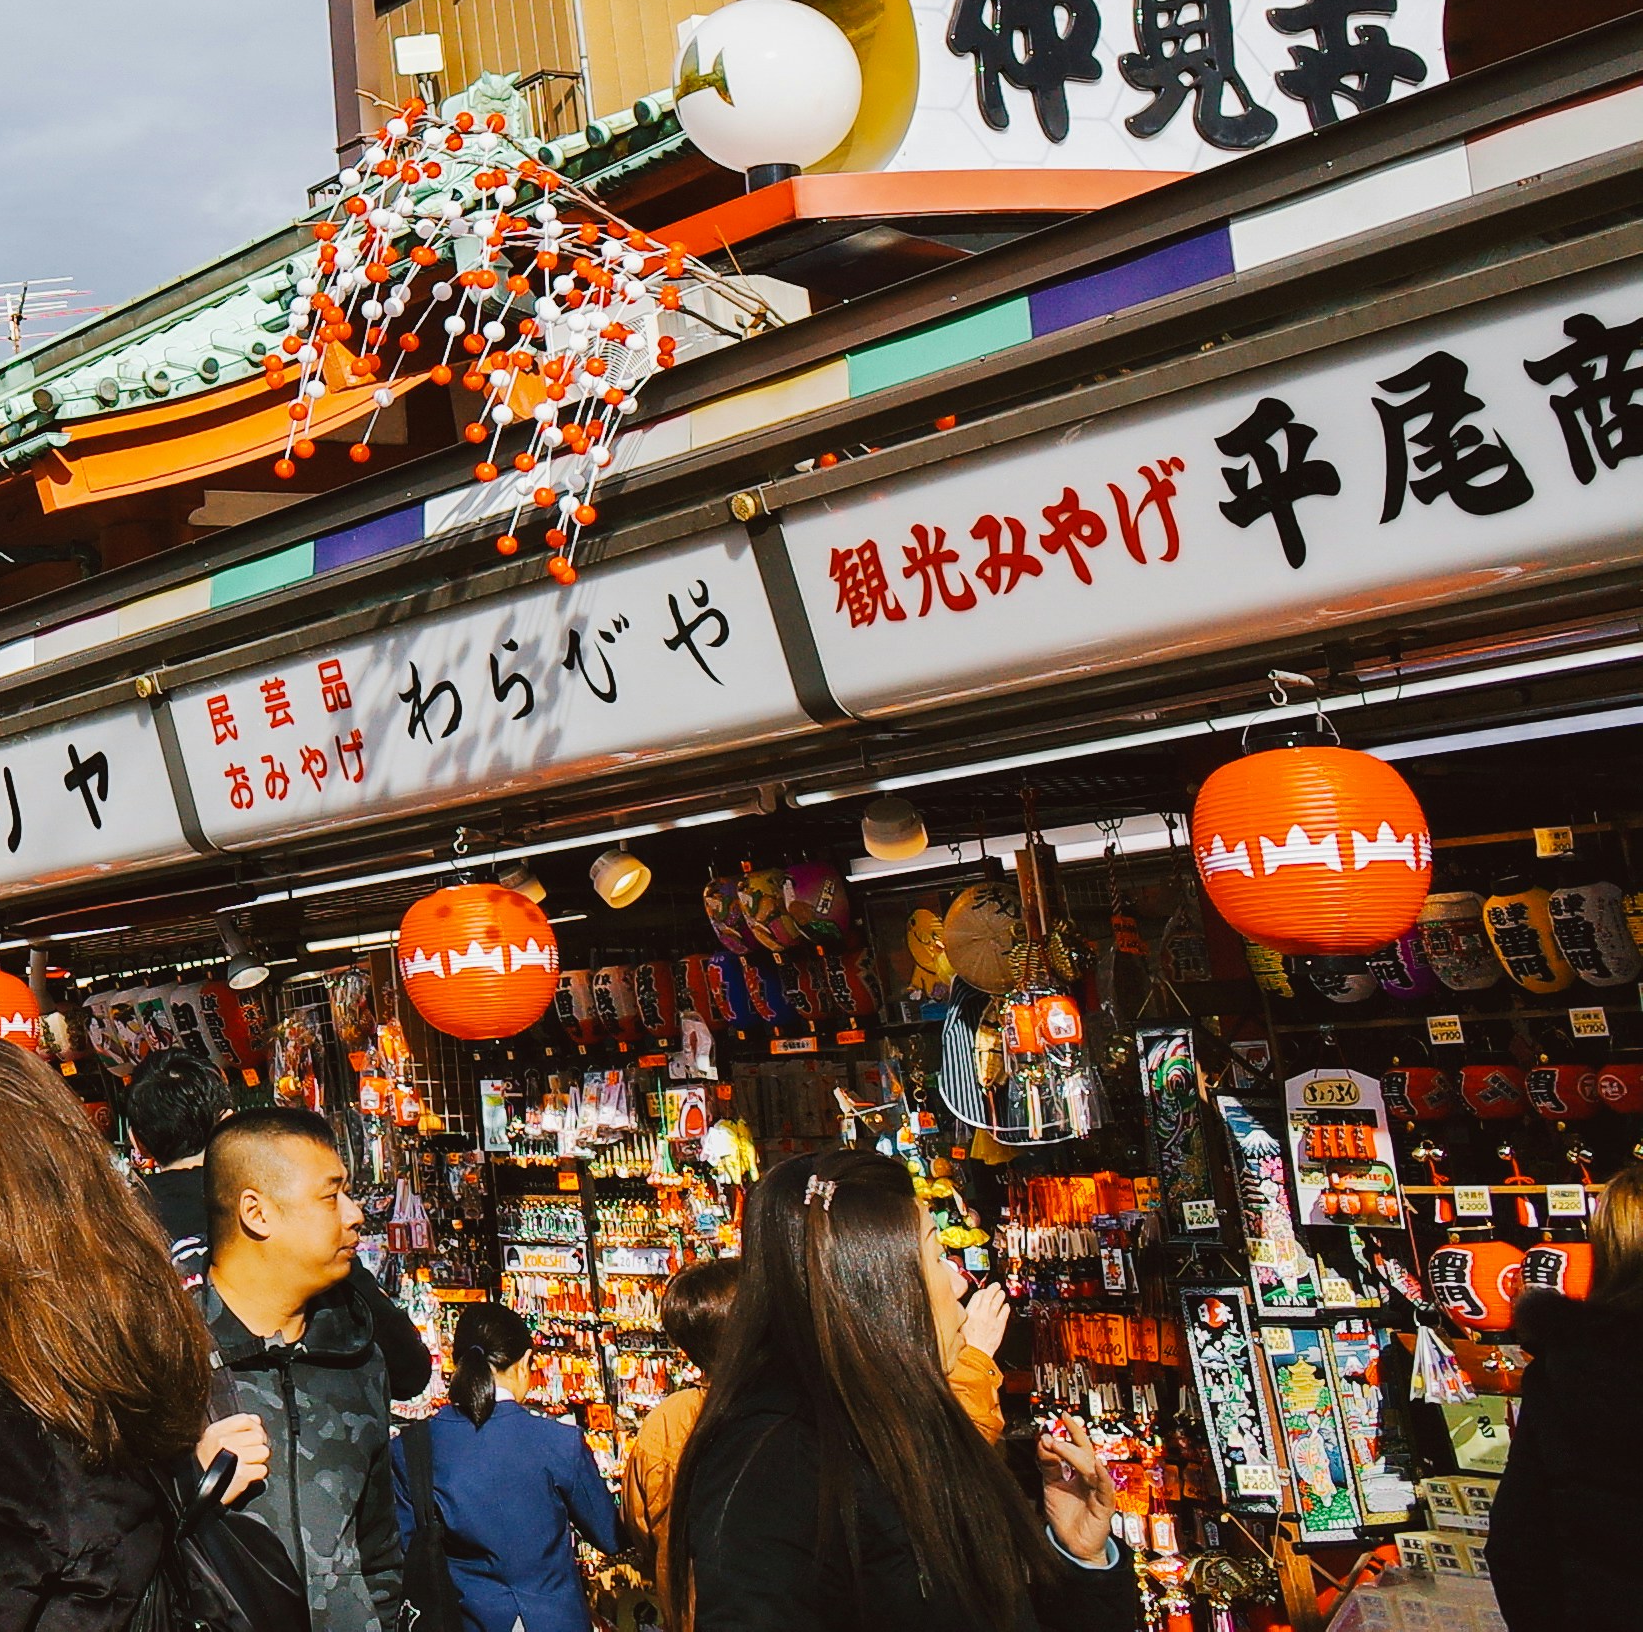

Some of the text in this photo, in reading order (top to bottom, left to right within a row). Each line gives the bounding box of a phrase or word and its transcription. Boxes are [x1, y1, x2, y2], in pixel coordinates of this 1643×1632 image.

[828, 312, 1643, 630] 観光みやげ 平尾商
[206, 659, 353, 747] 民芸品
[397, 579, 731, 745] わらびや
[224, 728, 365, 811] おみやげ
[523, 1253, 567, 1269] KOKESHI
[1271, 1294, 1309, 1307] JAPAN
[1429, 1250, 1485, 1317] 雷門
